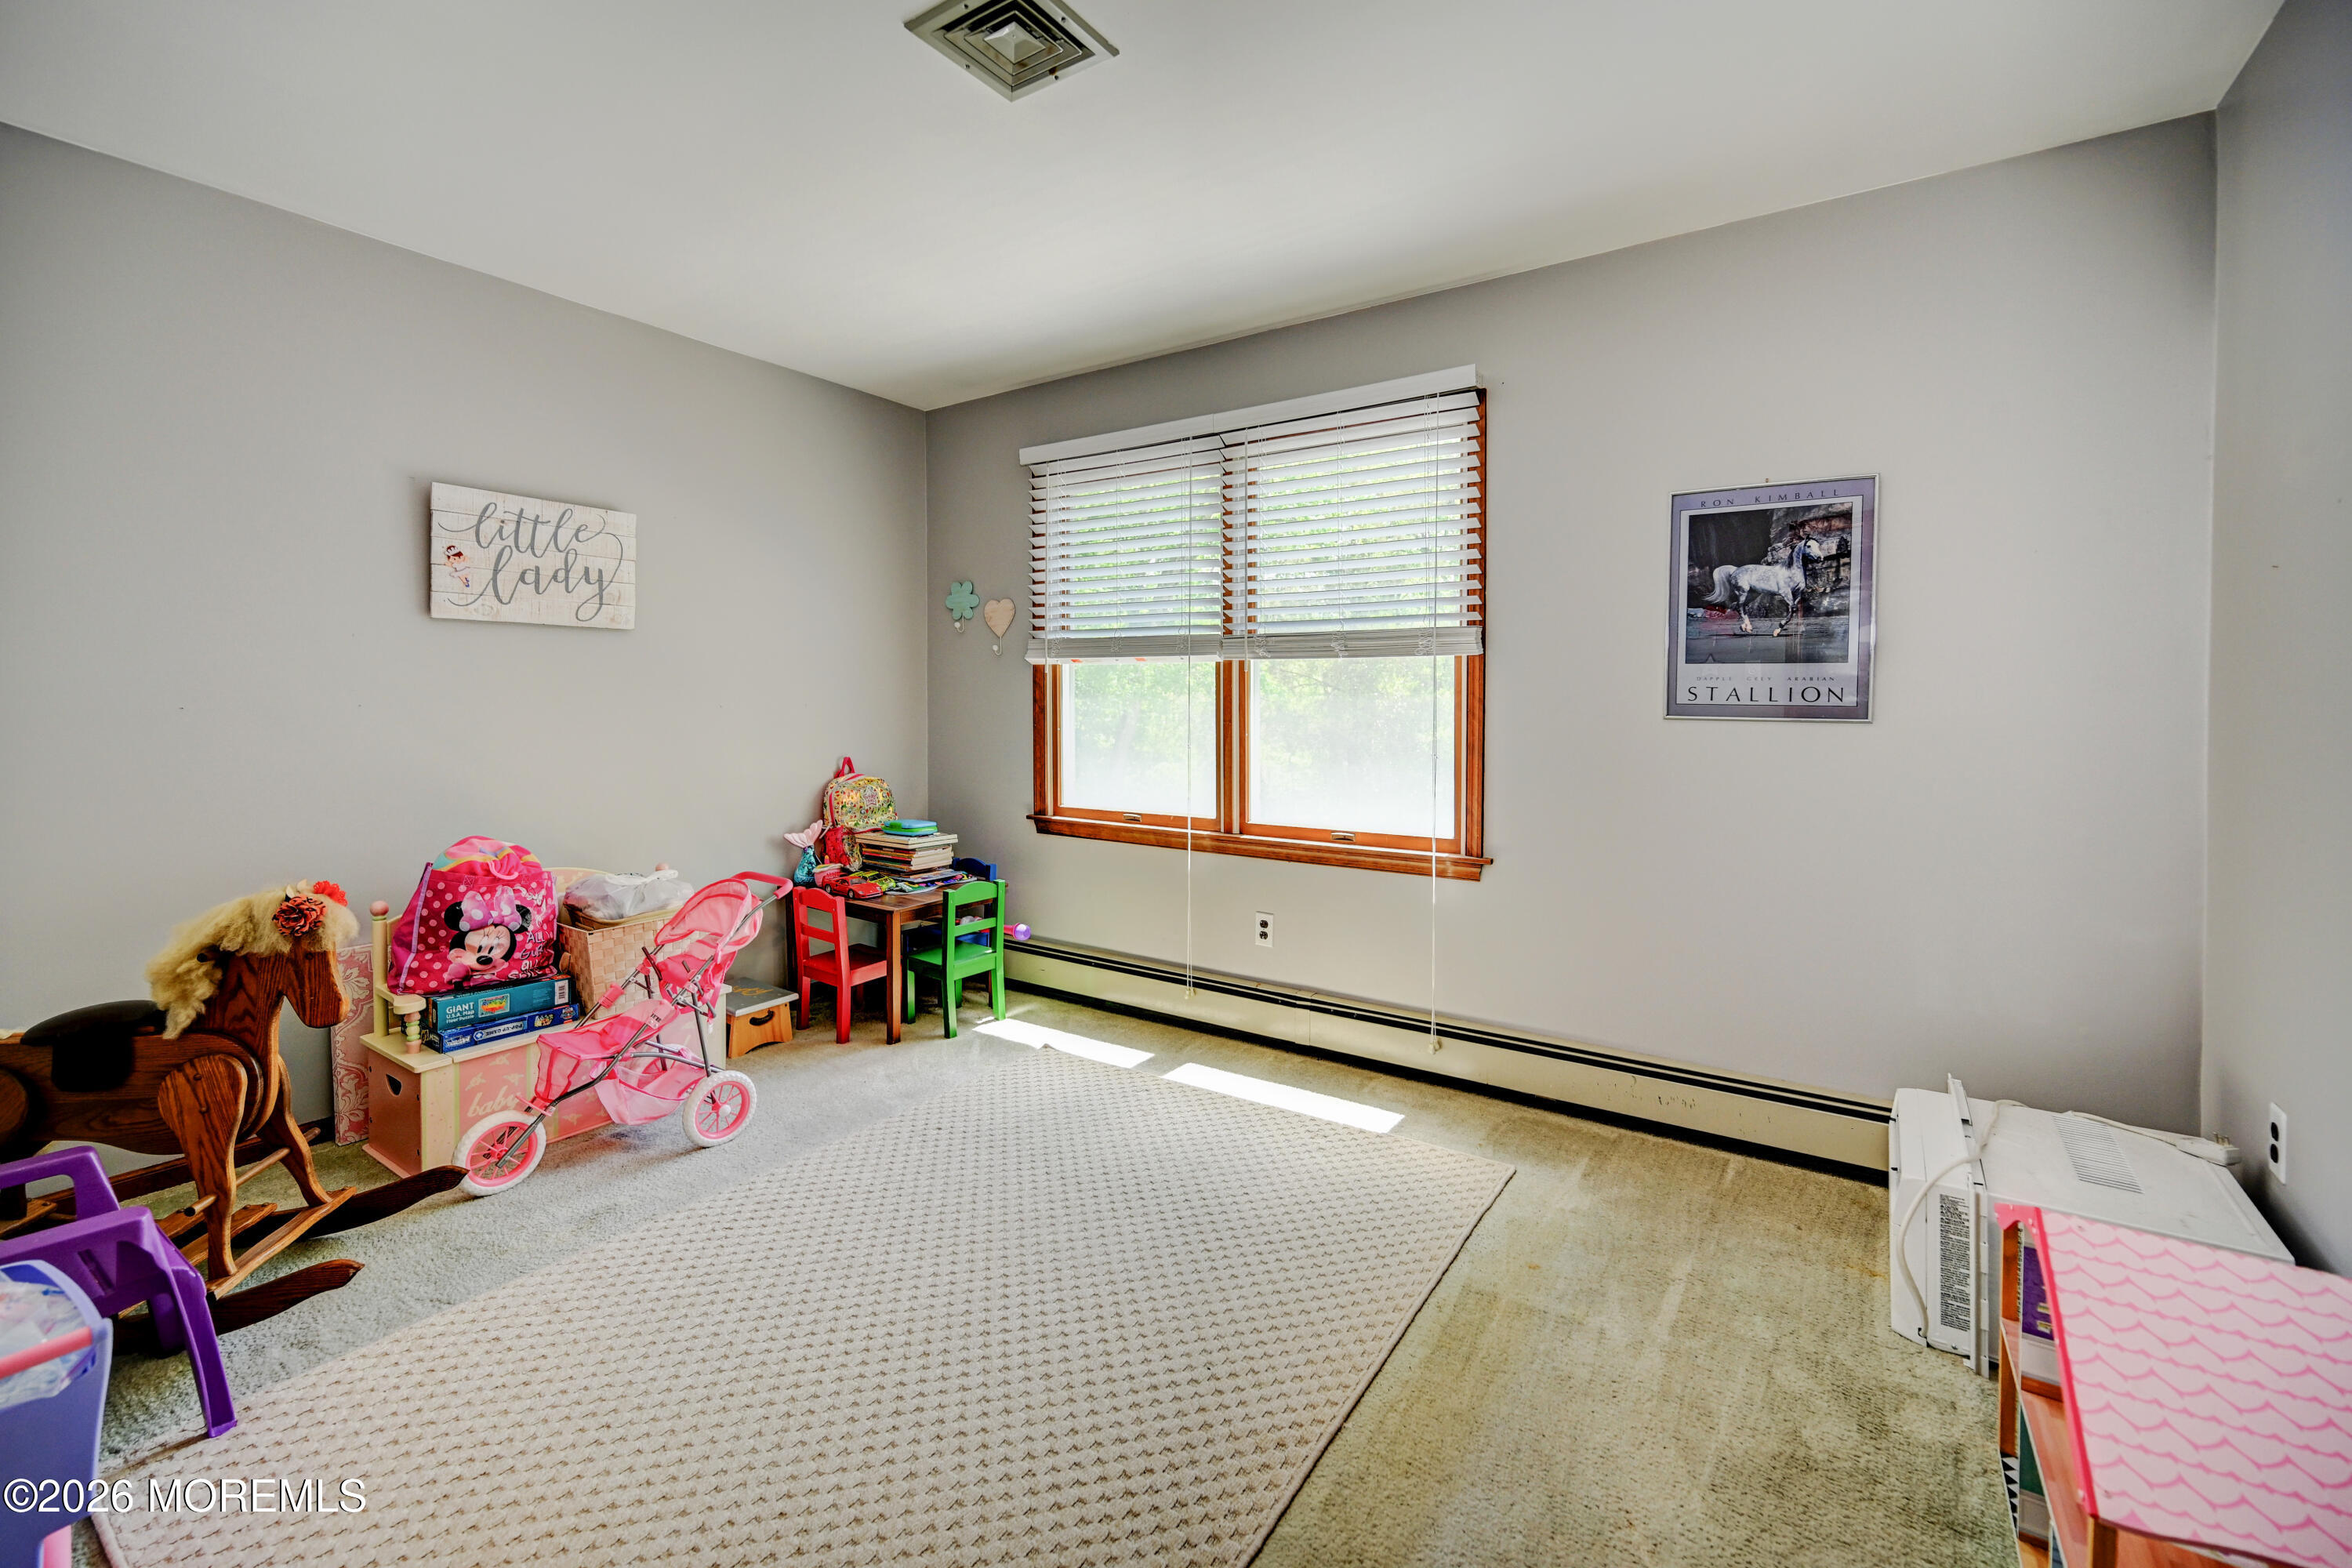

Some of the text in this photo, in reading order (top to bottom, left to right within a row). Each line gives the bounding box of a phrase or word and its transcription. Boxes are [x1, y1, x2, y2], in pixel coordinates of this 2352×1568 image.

[1700, 489, 1838, 507] RON KIMBALL
[438, 503, 606, 557] little
[447, 532, 623, 621] lady
[1688, 686, 1844, 702] STALLION
[446, 1002, 474, 1014] GIANT
